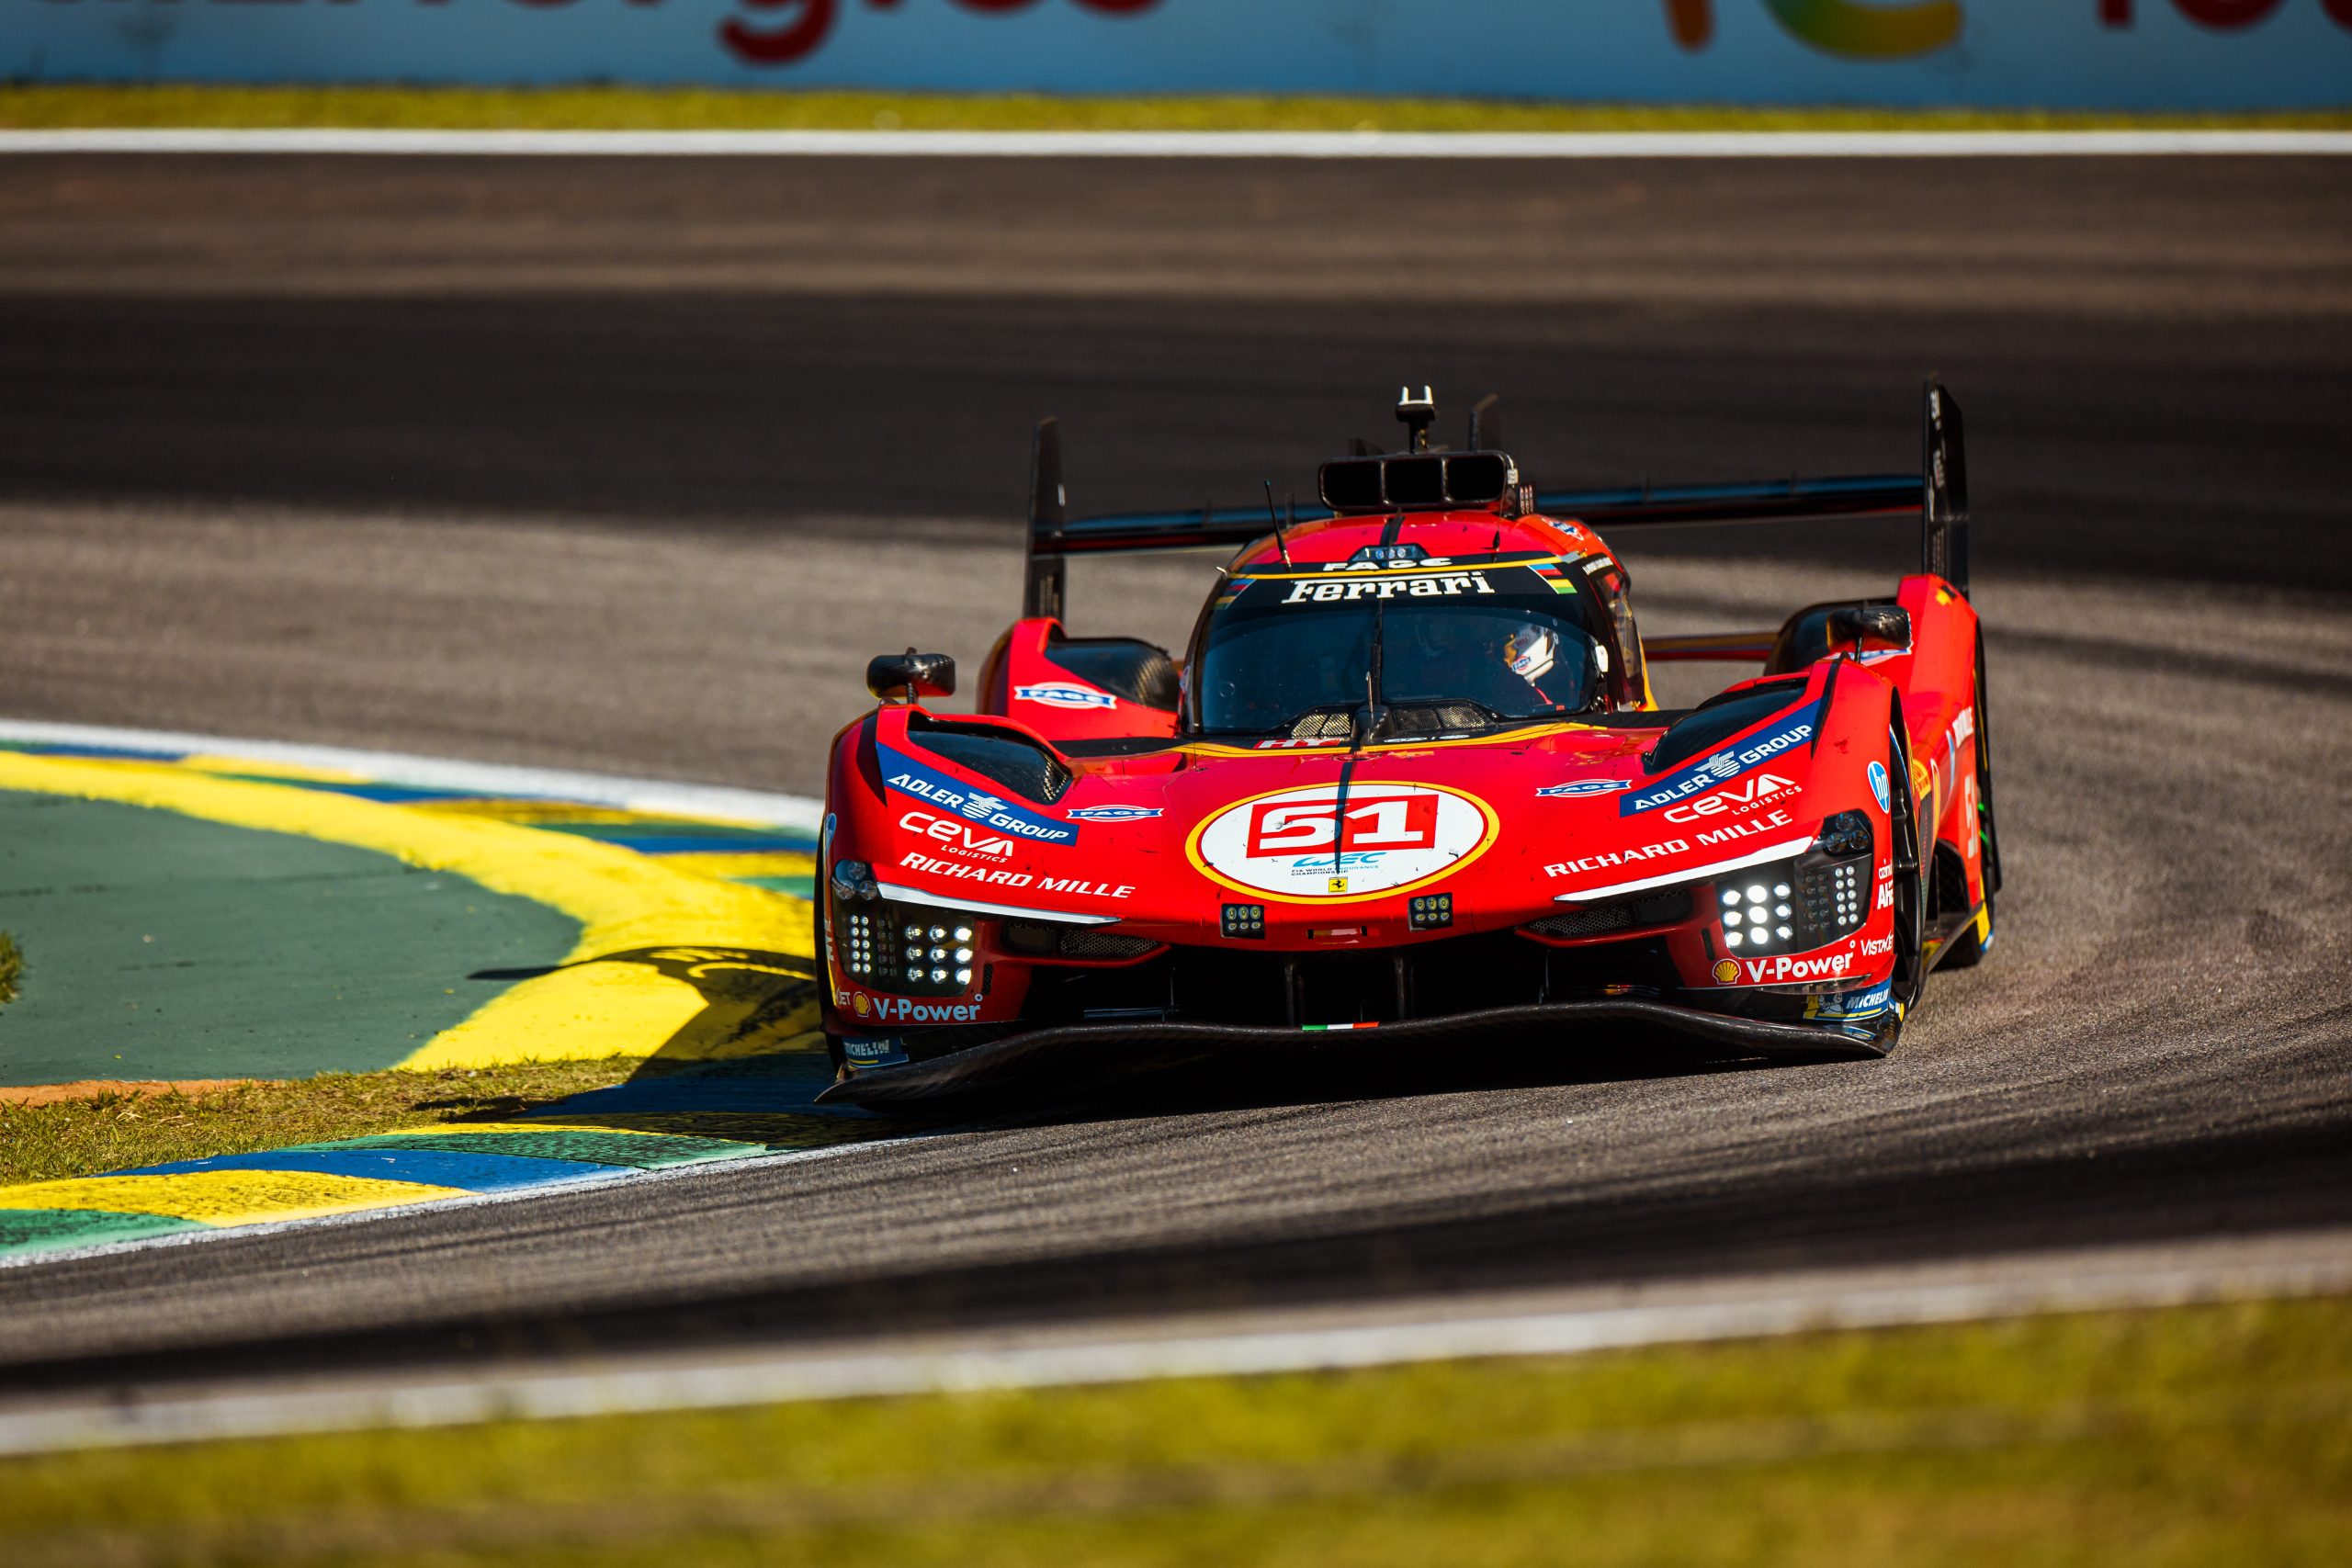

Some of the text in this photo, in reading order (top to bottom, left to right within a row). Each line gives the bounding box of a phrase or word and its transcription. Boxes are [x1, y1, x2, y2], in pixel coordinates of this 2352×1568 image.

[1281, 570, 1496, 604] Ferrari
[1633, 724, 1814, 810] ADLER GROUP
[1732, 785, 1803, 816] LOGISTICS
[1871, 763, 1889, 806] hp
[887, 773, 1069, 840] ADLER GROUP
[1259, 800, 1424, 850] 51
[941, 844, 1008, 863] LOGISTICS
[1292, 852, 1387, 868] WEC
[1543, 808, 1793, 878] RICHARD MILLE
[899, 852, 1136, 899] RICHARD MILLE
[1747, 950, 1854, 983] V-Power
[873, 998, 981, 1021] V-Power
[1846, 988, 1890, 1010] MICHELIN
